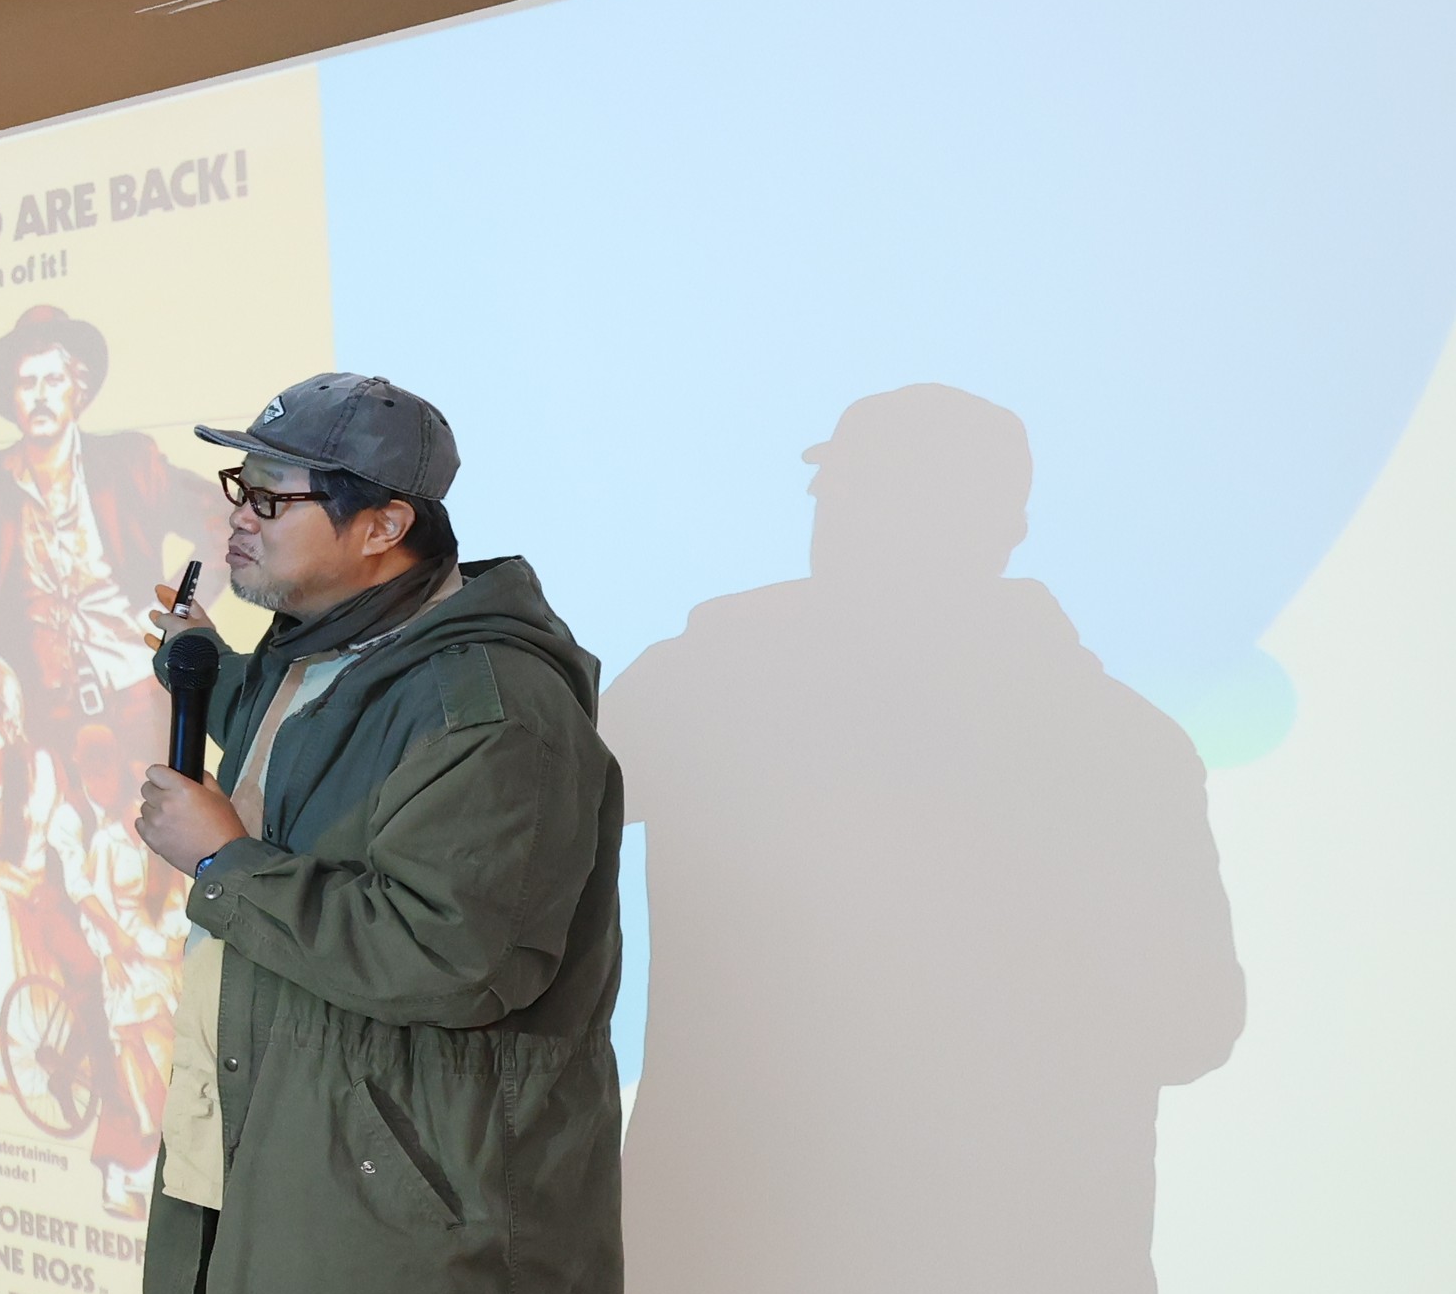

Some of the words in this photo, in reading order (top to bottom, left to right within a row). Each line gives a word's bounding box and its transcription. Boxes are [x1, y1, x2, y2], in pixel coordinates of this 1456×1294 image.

[13, 183, 97, 242] ARE
[110, 149, 249, 222] BACK!
[11, 257, 36, 285] of
[39, 250, 68, 279] it!
[33, 1252, 95, 1294] ROSS
